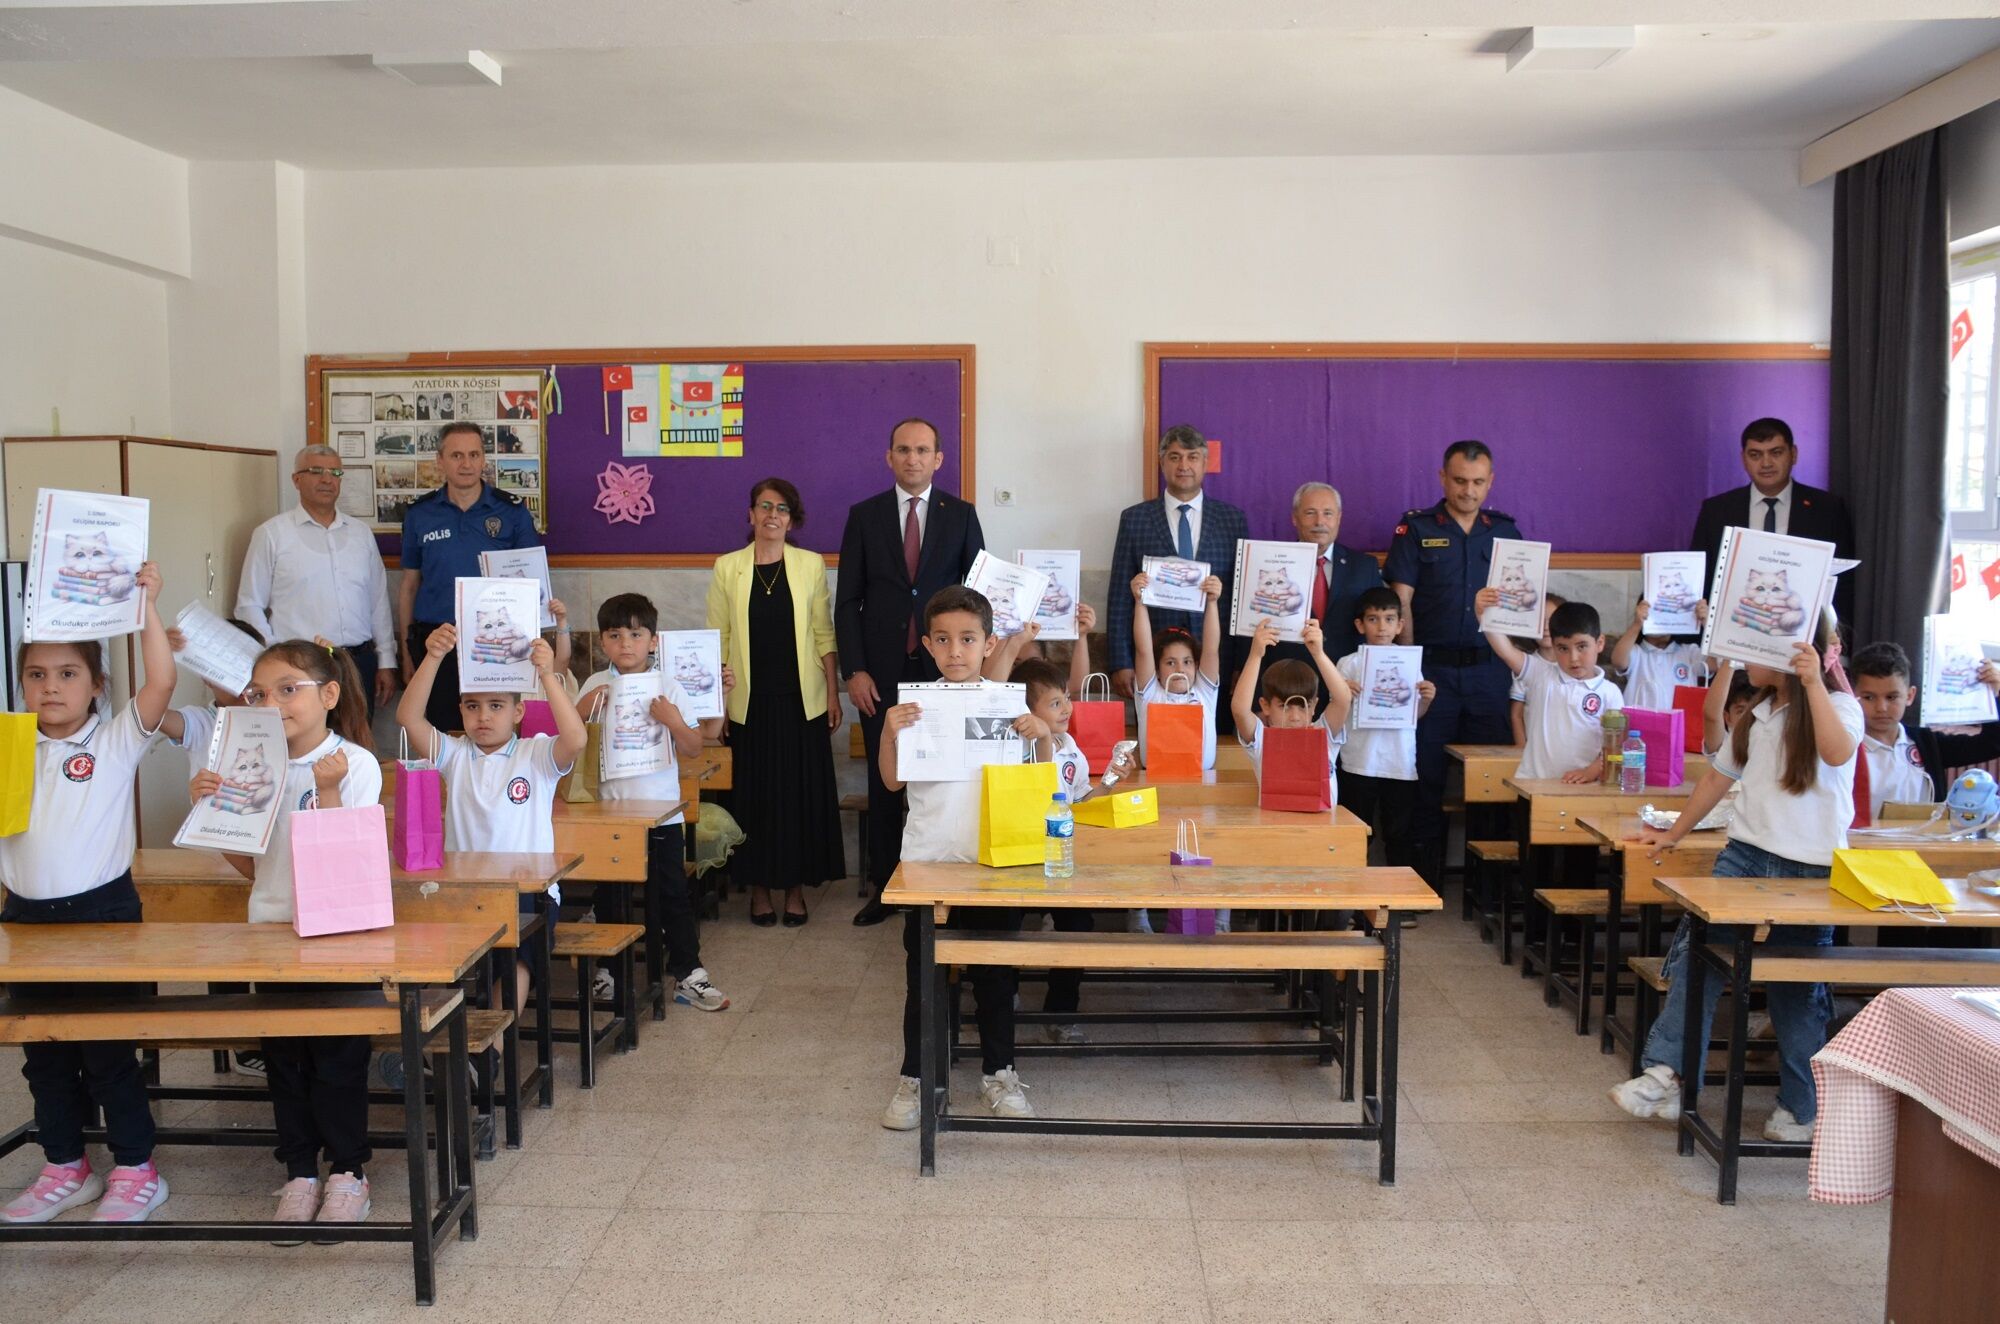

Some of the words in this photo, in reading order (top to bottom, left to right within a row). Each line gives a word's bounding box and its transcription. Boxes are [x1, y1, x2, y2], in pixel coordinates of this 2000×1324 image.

[412, 378, 460, 389] ATATÜRK
[464, 377, 501, 390] KÖŞESİ
[51, 619, 89, 628] Okudukça
[1727, 639, 1759, 651] Okudukça
[200, 826, 226, 836] Okudukça
